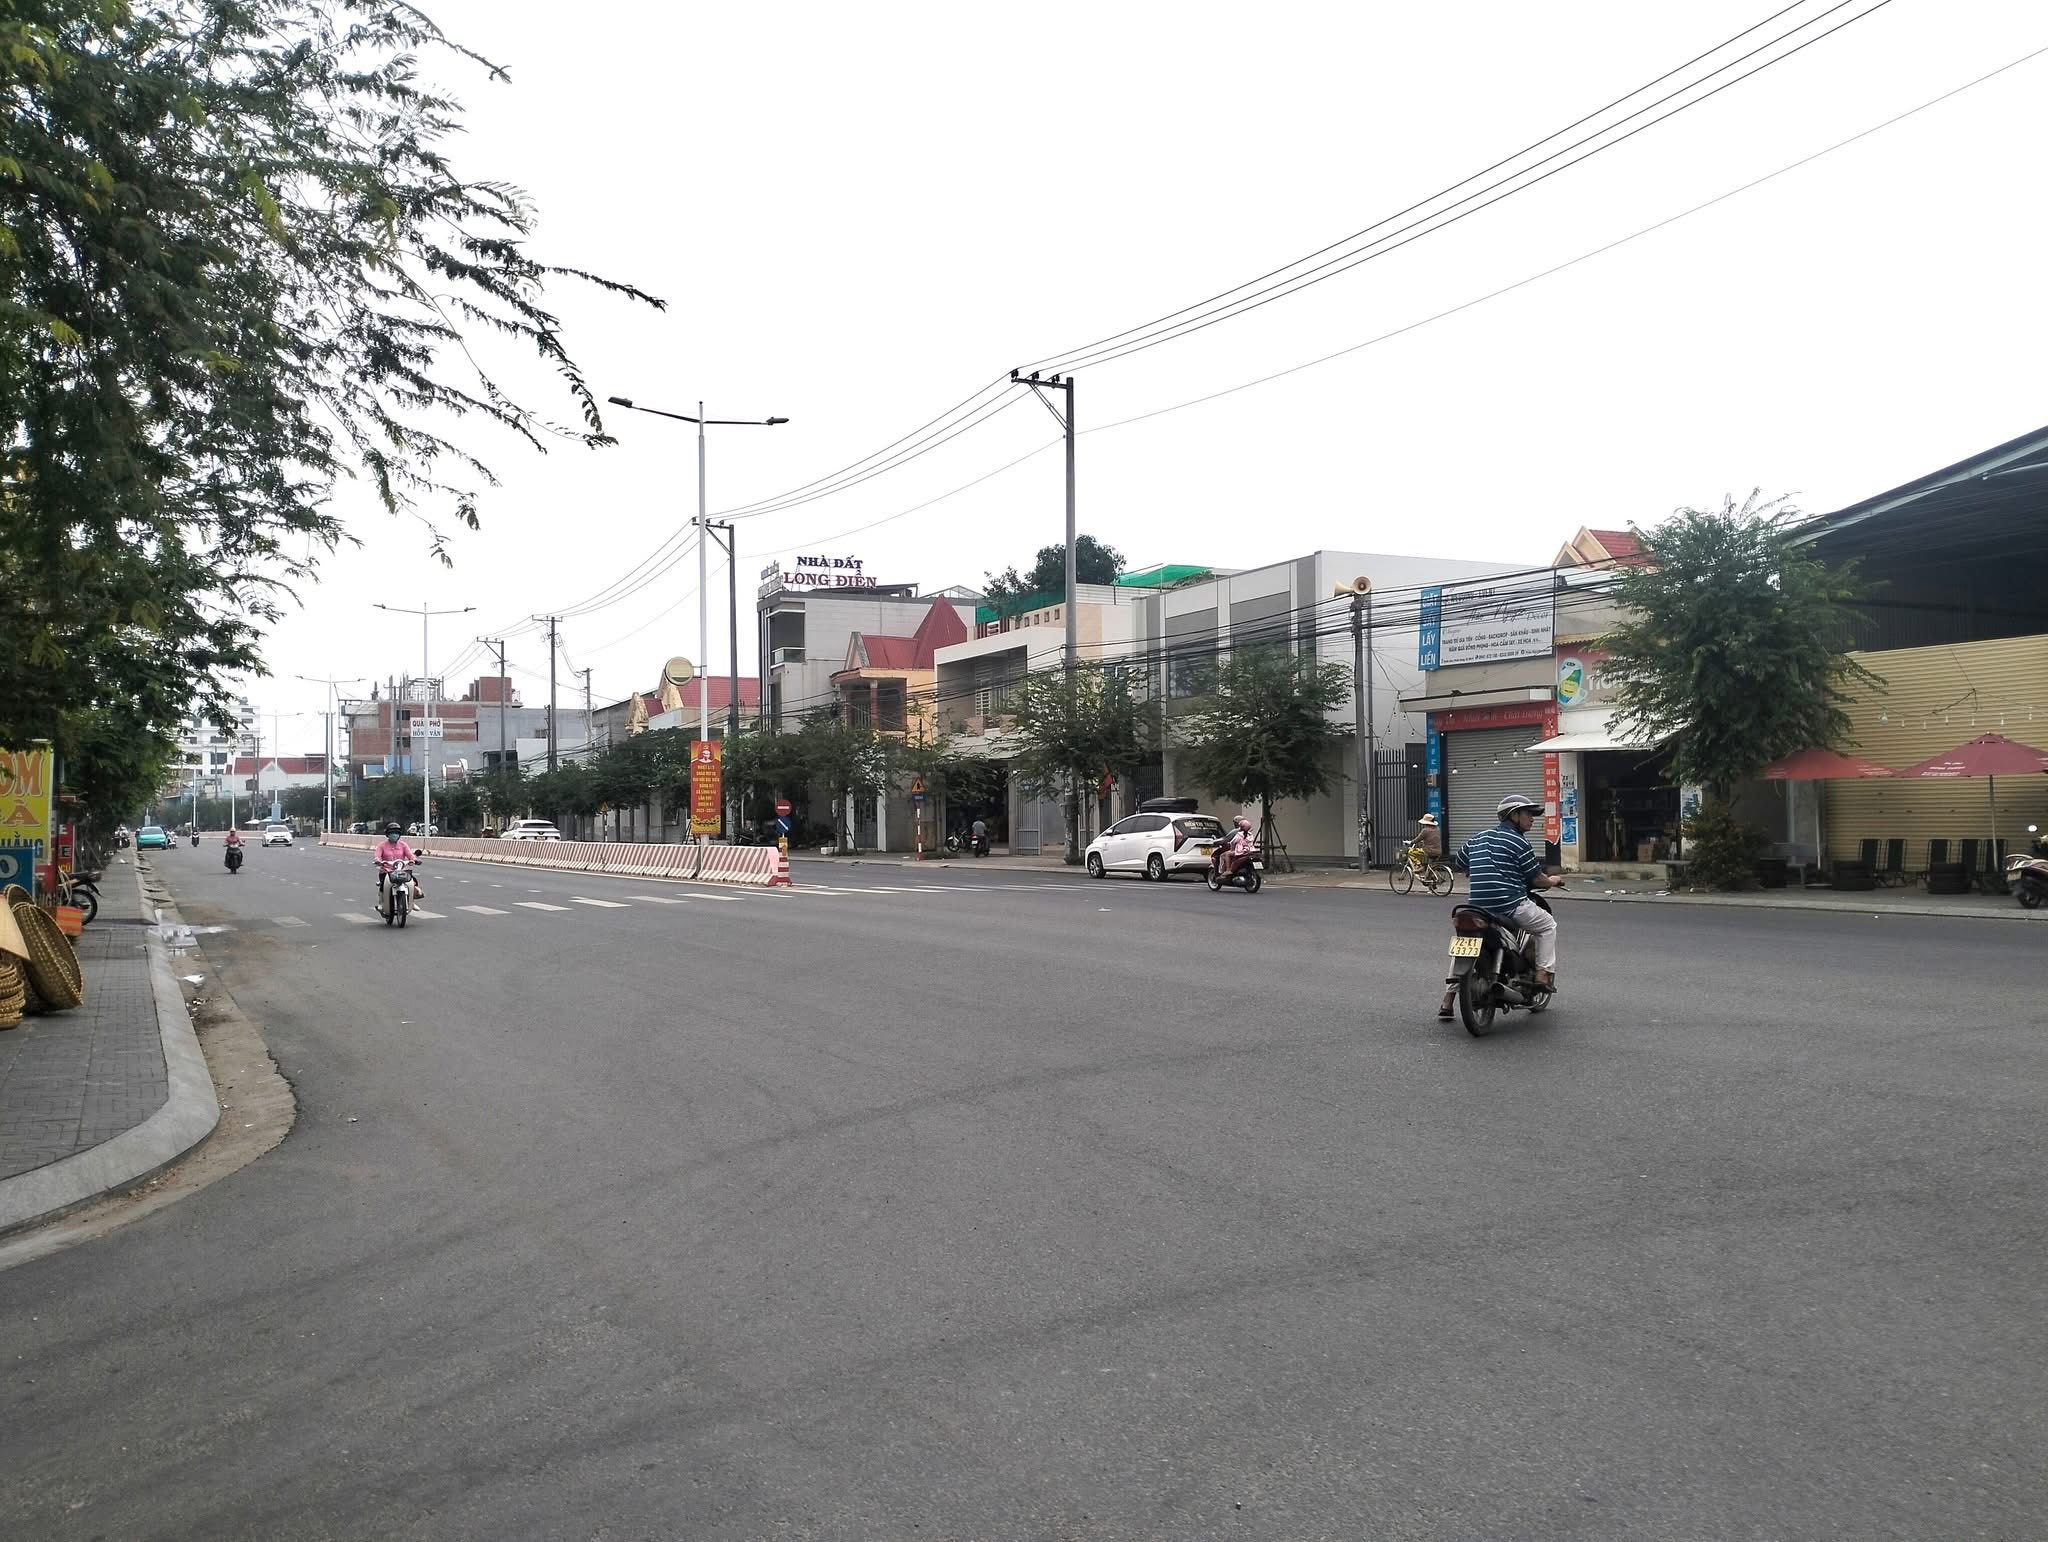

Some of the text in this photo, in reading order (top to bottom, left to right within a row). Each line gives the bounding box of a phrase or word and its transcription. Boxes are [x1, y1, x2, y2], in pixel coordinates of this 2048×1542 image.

[797, 555, 829, 567] NHÀ
[784, 572, 830, 586] LONG
[1423, 630, 1436, 646] LẤY
